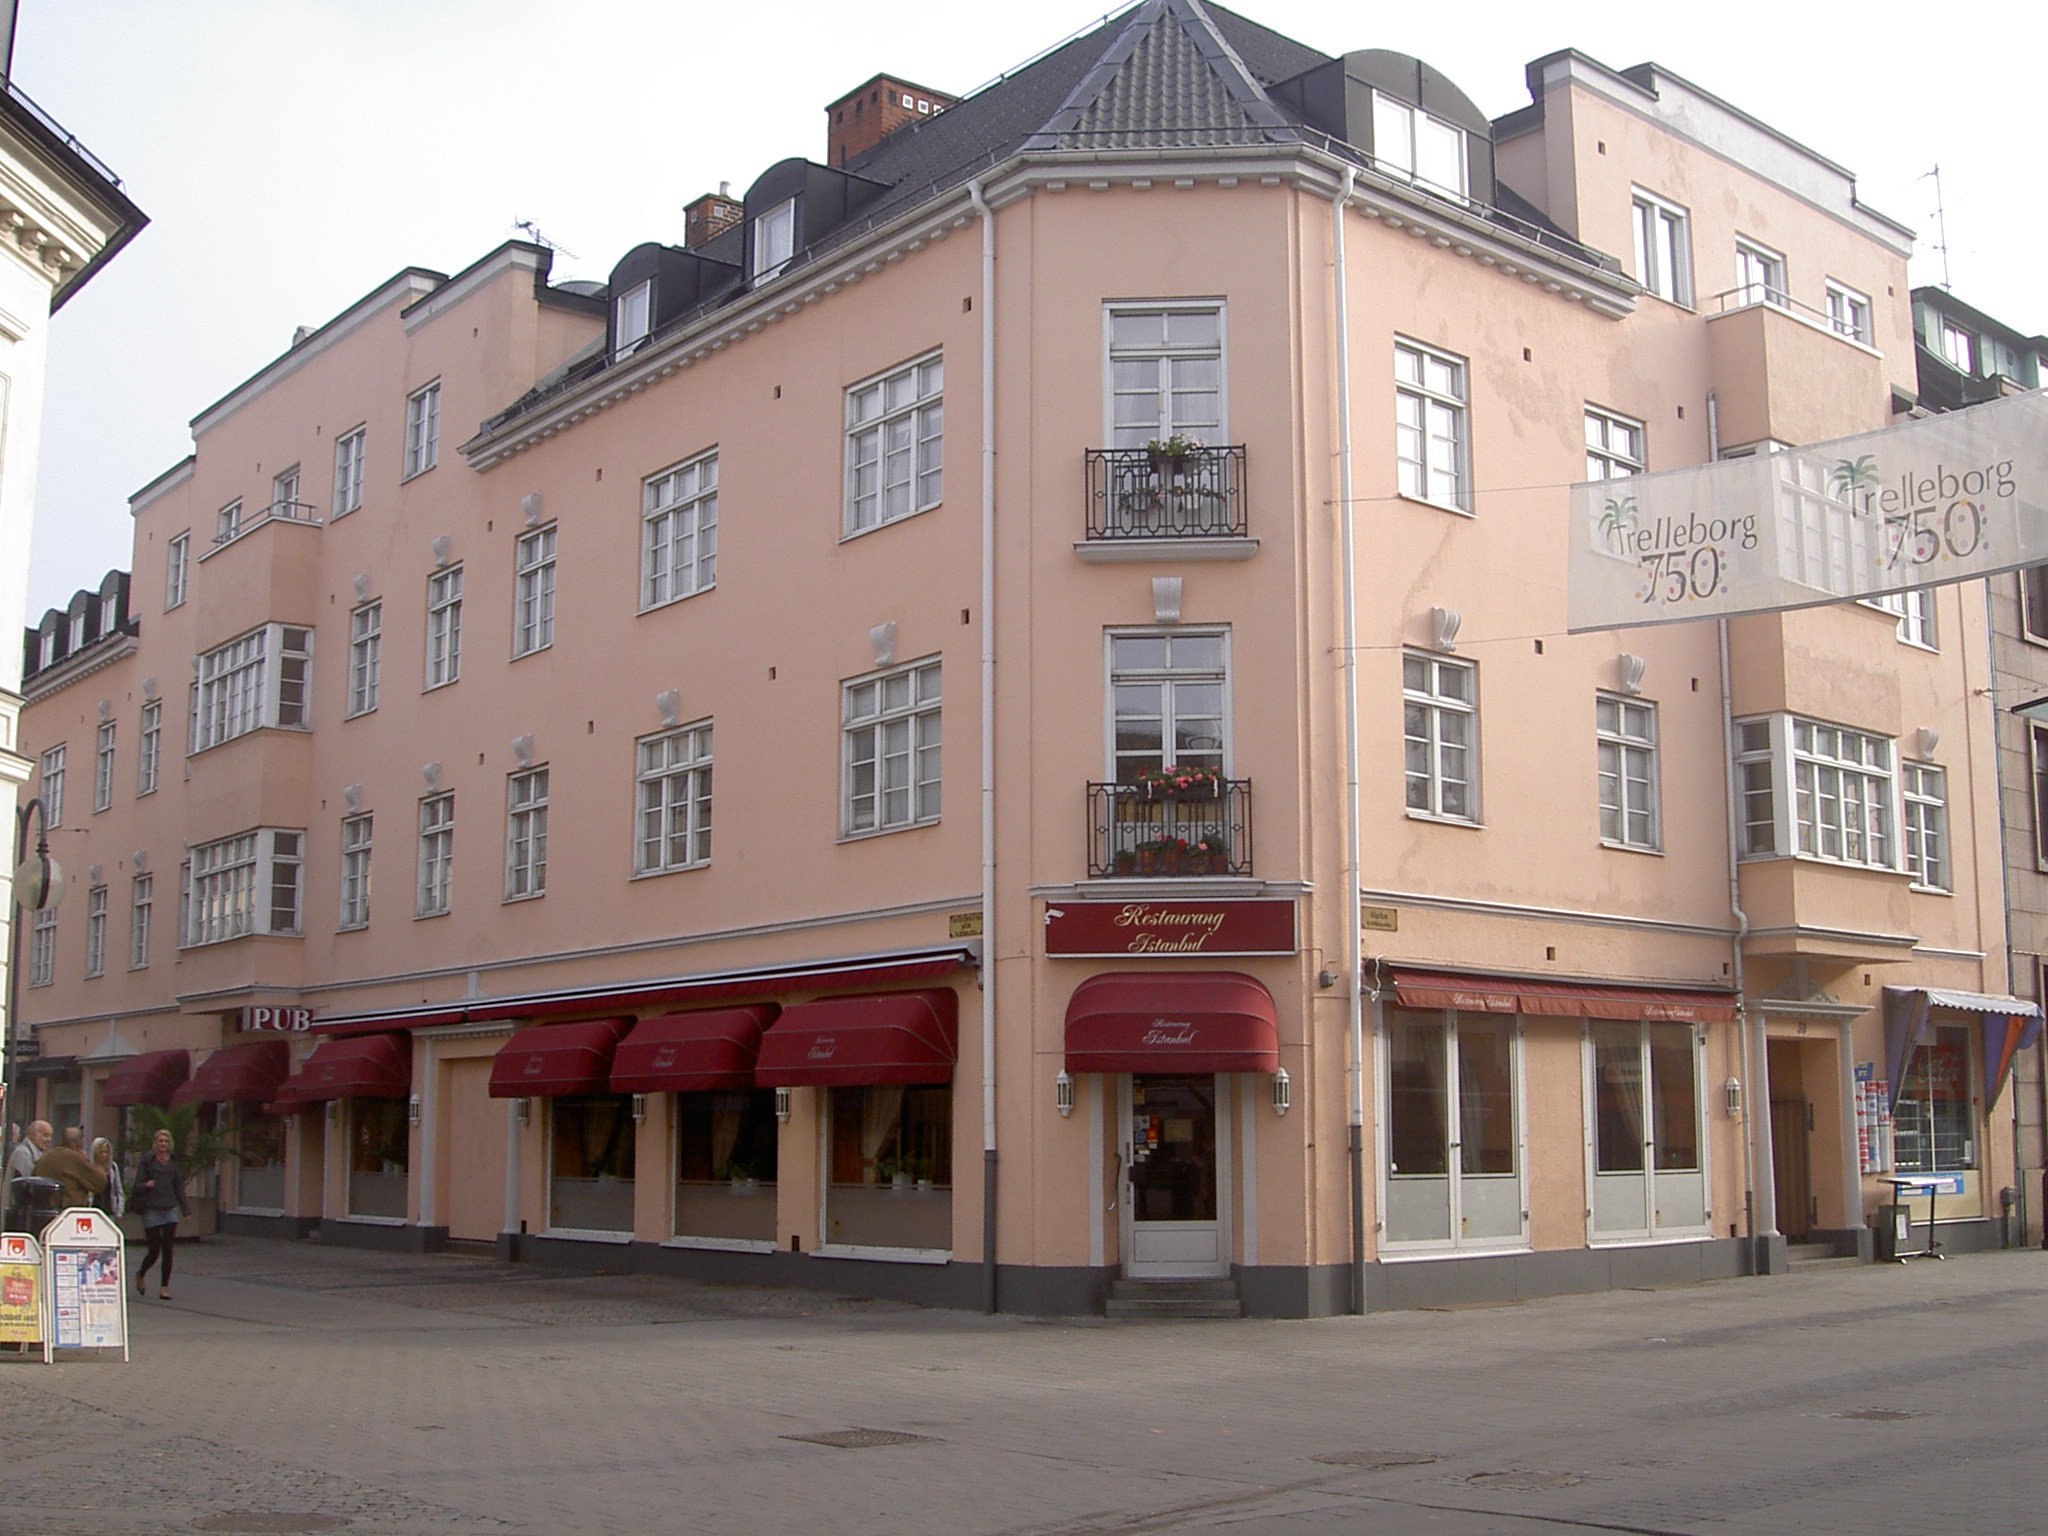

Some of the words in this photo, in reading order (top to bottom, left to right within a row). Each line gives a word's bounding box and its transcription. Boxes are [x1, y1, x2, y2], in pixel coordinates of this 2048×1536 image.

[1845, 459, 2016, 518] Trelleborg
[1613, 512, 1758, 555] Trelleborg
[1884, 500, 1981, 571] 750
[1641, 546, 1720, 603] 750
[1114, 903, 1226, 932] Restaurang
[1127, 932, 1213, 953] Istanbul
[252, 1007, 311, 1032] PUB
[1141, 1029, 1199, 1045] Istanbul
